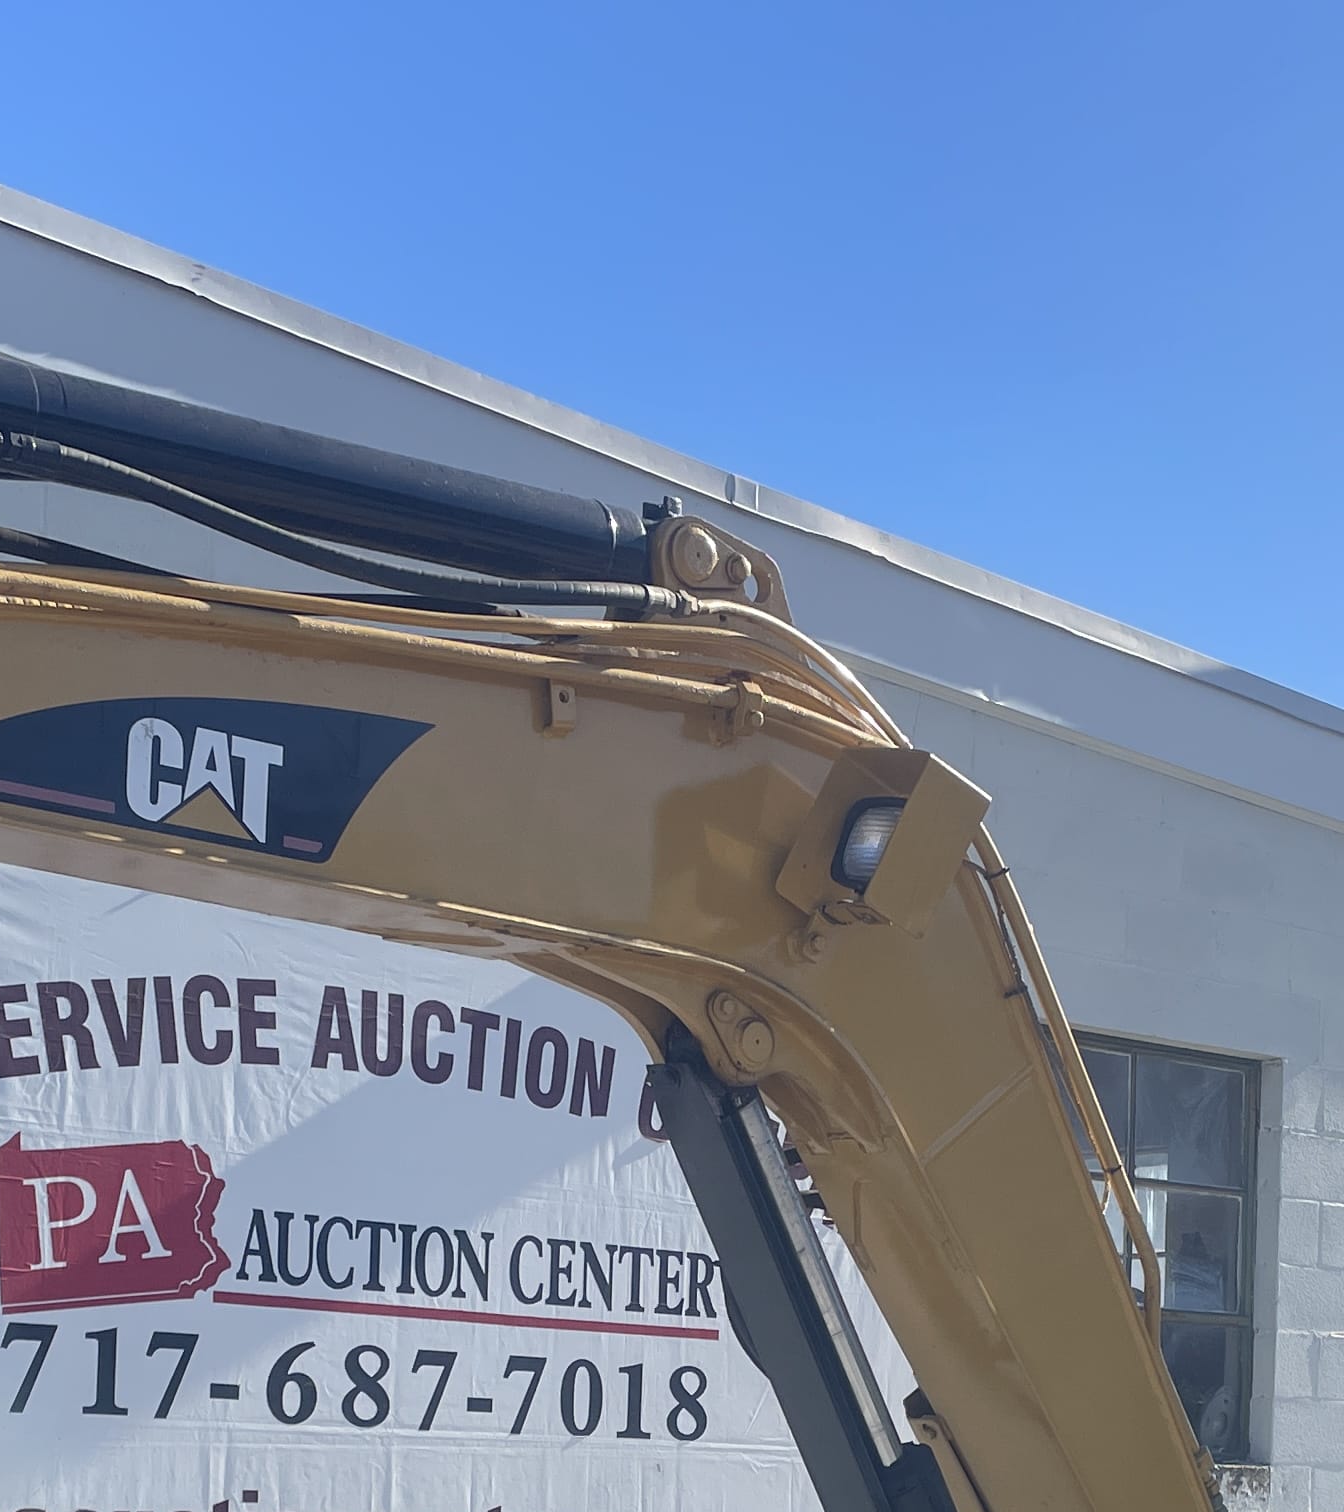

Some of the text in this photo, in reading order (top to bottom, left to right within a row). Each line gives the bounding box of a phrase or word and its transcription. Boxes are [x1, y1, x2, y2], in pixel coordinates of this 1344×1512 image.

[126, 717, 284, 844] CAT
[311, 985, 617, 1118] AUCTION
[22, 1168, 718, 1319] PA AUCTION CENTER
[0, 1321, 708, 1442] 717-687-7018
